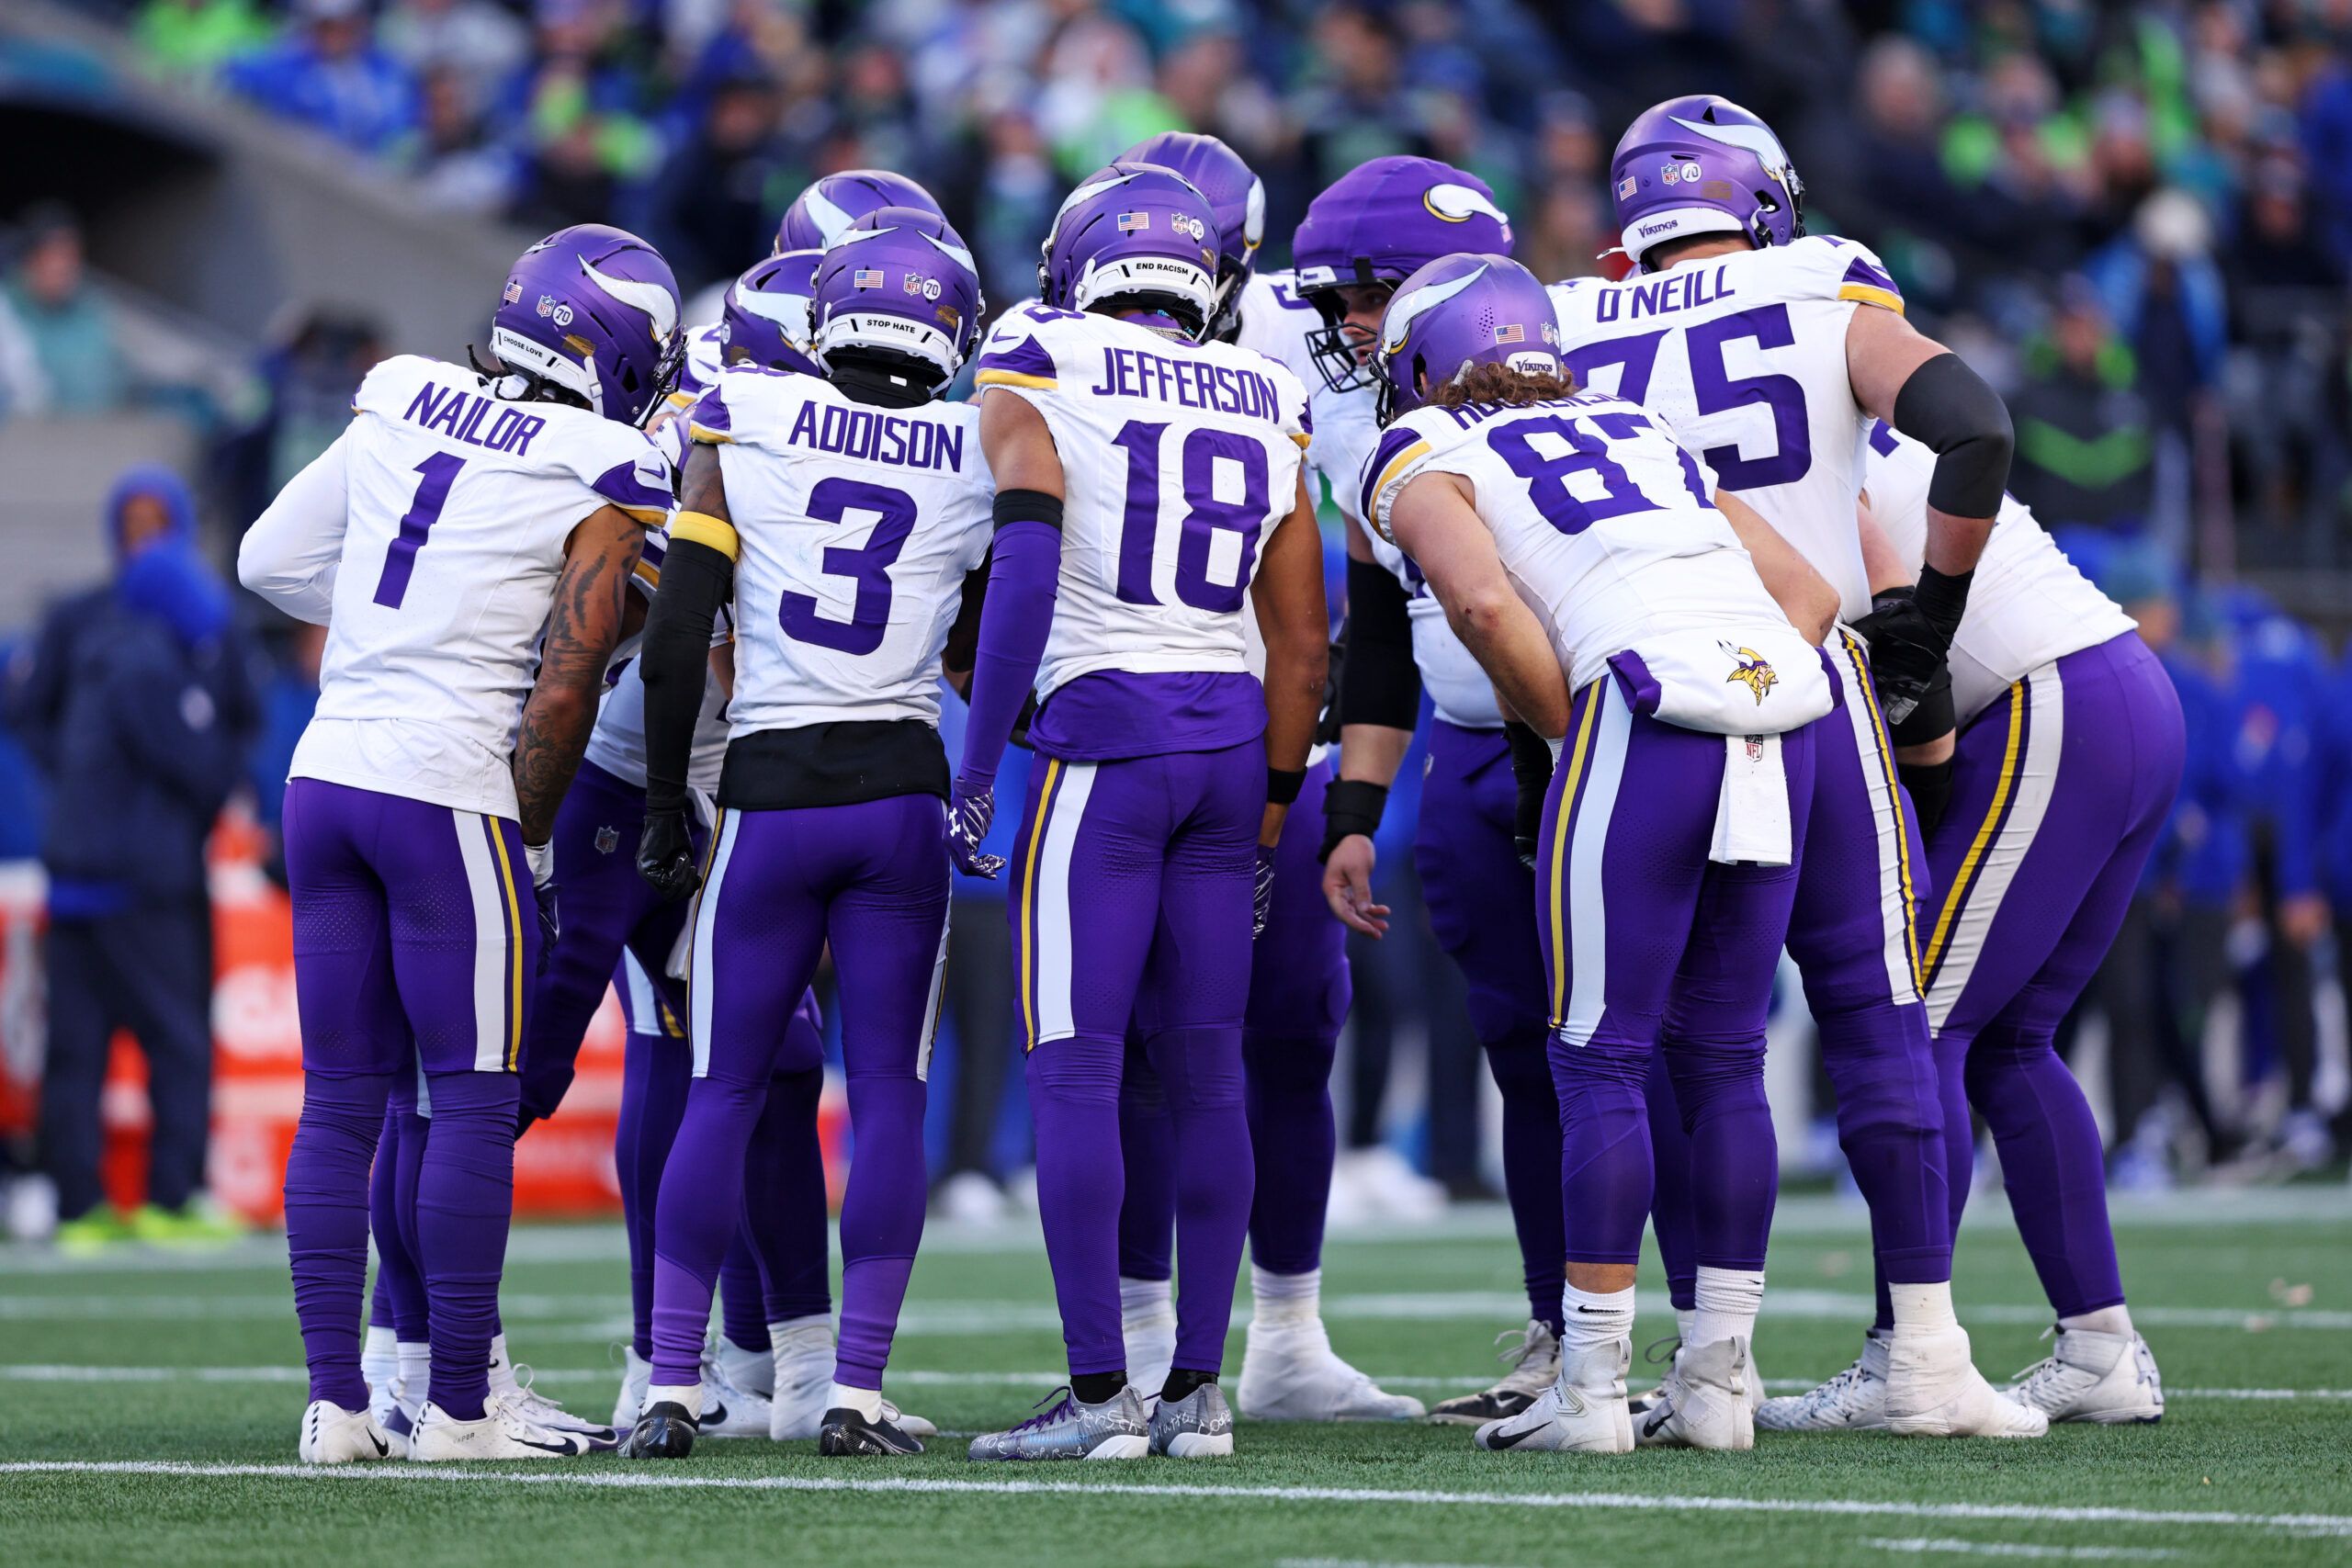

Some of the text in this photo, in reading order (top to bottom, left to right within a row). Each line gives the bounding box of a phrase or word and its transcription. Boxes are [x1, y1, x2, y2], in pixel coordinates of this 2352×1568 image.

[1683, 166, 1700, 179] 70
[925, 282, 939, 297] 70
[1157, 264, 1189, 276] RACISM
[1596, 265, 1736, 323] O'NEILL
[503, 336, 544, 358] CHOOSE LOVE
[555, 308, 571, 323] 70
[866, 319, 916, 333] STOP HATE
[1092, 347, 1282, 424] JEFFERSON
[1562, 303, 1813, 491] 75
[403, 381, 546, 457] NAILOR
[787, 400, 964, 473] ADDISON
[1487, 412, 1717, 536] 87
[373, 451, 467, 610] 1
[1111, 420, 1272, 613] 18
[778, 477, 918, 656] 3
[1746, 742, 1760, 760] NFL
